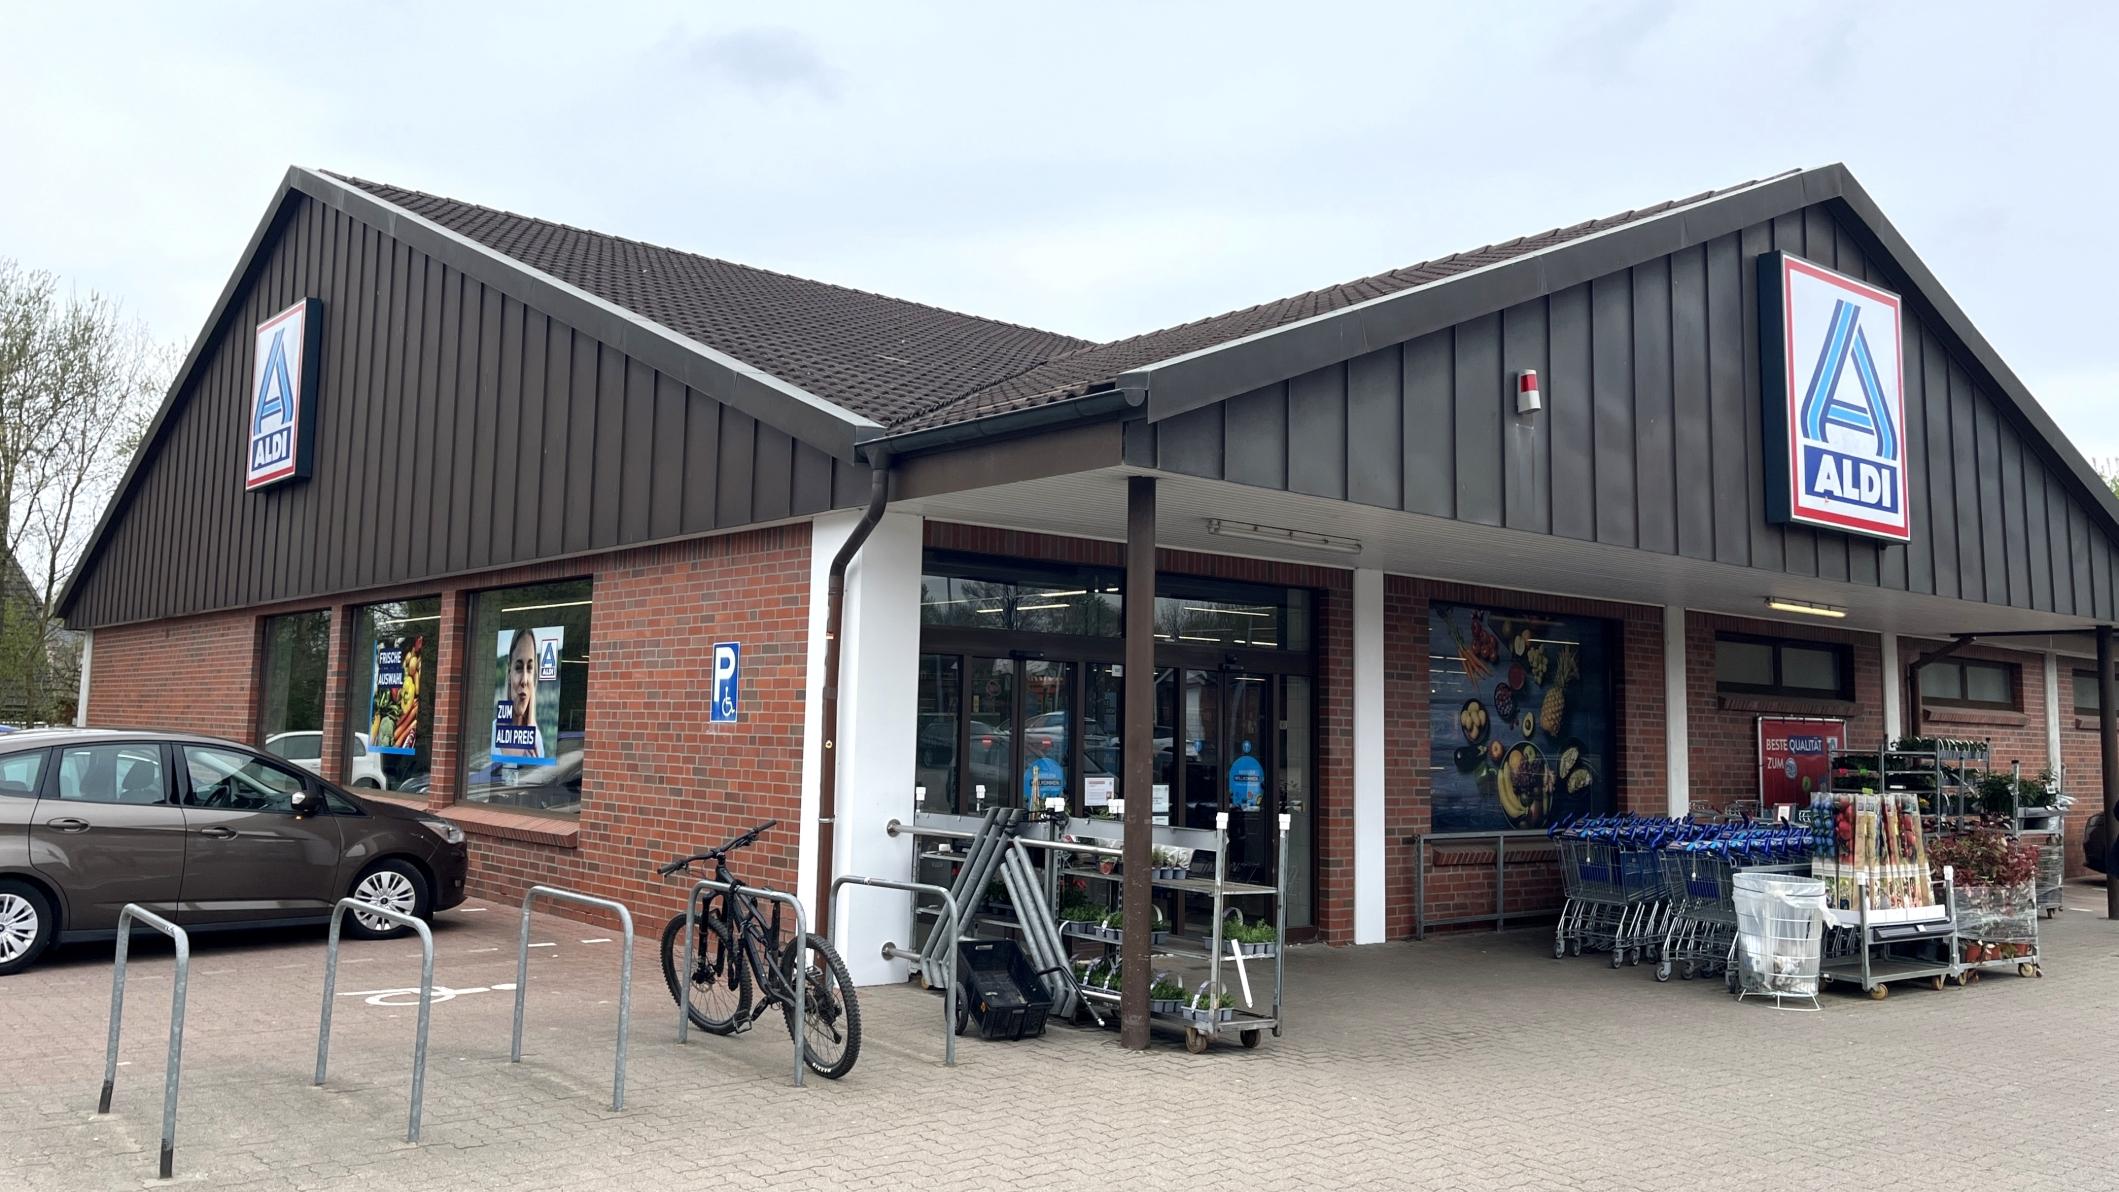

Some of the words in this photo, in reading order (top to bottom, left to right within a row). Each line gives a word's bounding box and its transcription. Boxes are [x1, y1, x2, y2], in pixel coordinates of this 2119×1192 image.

[254, 431, 288, 467] ALDI
[1814, 453, 1892, 508] ALDI
[380, 651, 402, 664] FRISCHE
[378, 672, 403, 685] AUSWAHL
[542, 668, 554, 676] ALDI
[713, 646, 736, 702] P
[497, 704, 513, 719] ZUM
[496, 729, 513, 744] ALDI
[513, 729, 535, 745] PREIS
[1766, 738, 1788, 751] BESTE
[1789, 736, 1822, 754] QUALITÄT
[1767, 757, 1785, 769] ZUM
